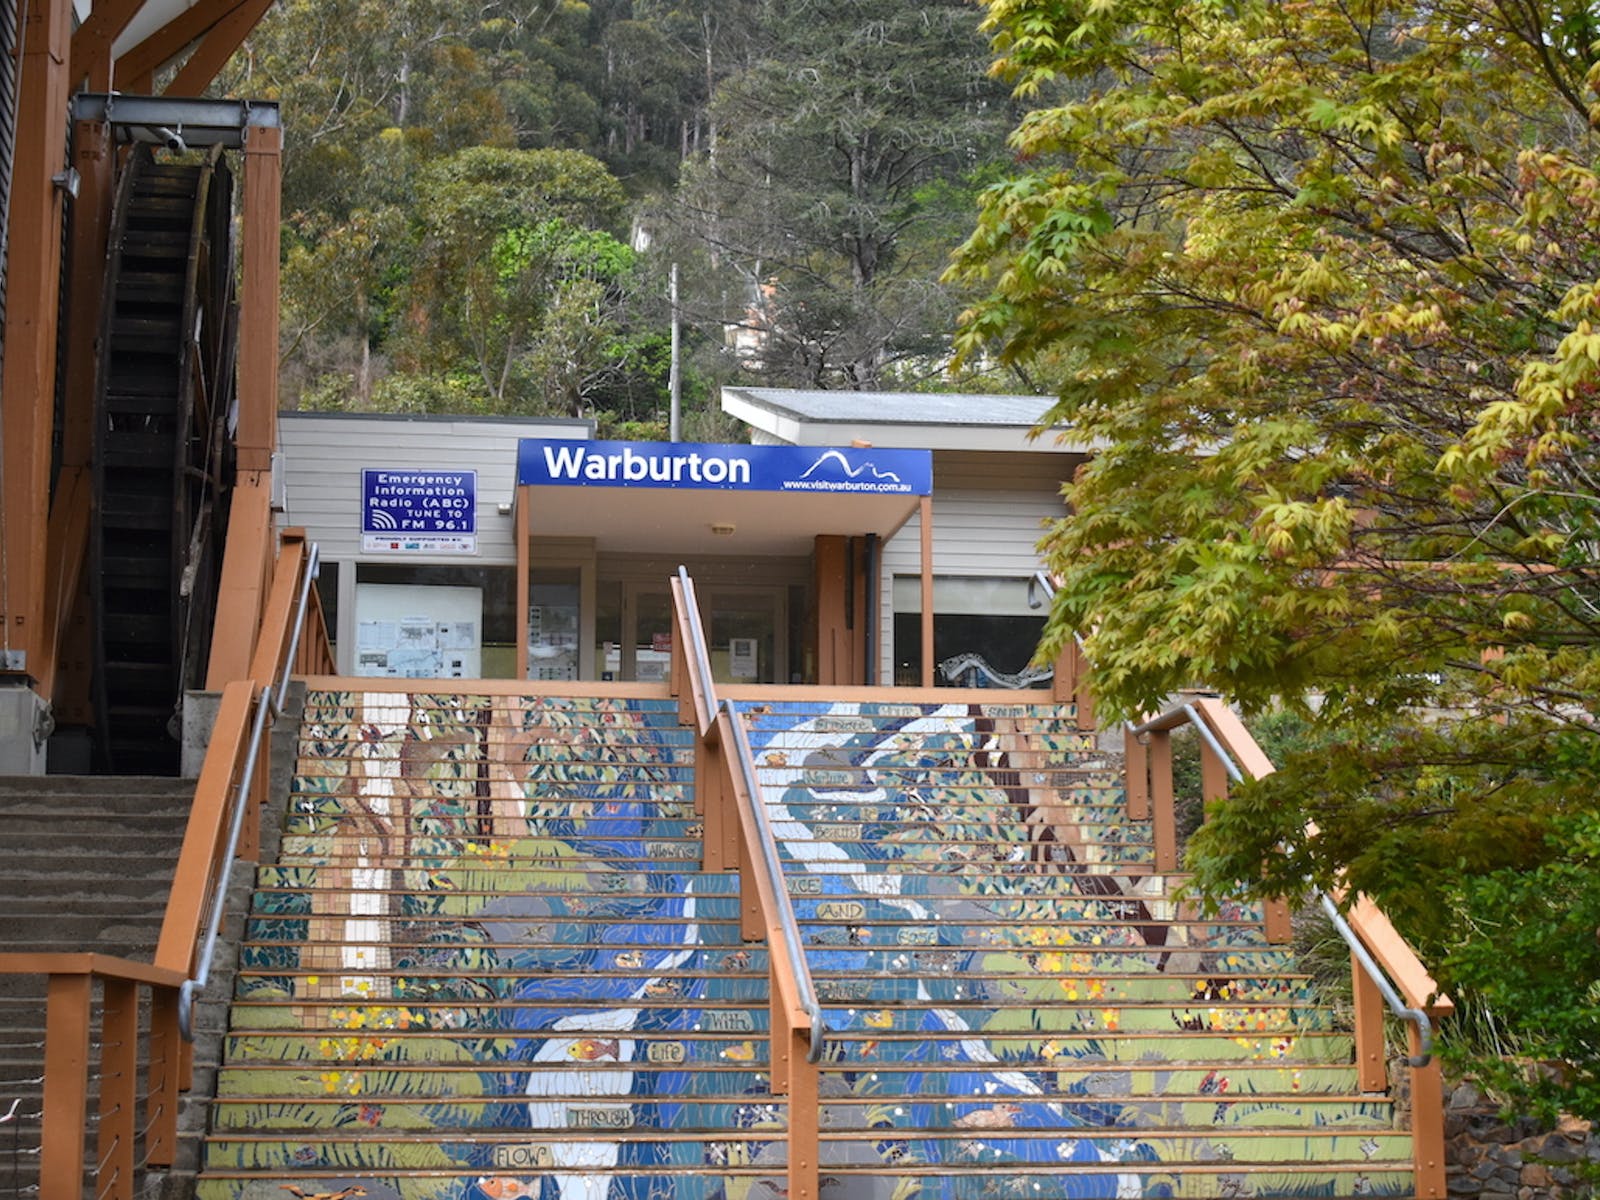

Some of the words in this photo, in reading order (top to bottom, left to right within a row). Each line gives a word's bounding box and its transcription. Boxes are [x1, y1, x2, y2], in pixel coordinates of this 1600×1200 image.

[543, 446, 751, 484] Warburton
[378, 474, 463, 486] Emergency
[783, 480, 912, 492] www.visitwarburton.com.au
[375, 486, 465, 496] Information
[369, 497, 412, 507] Radio
[422, 498, 470, 509] (ABC)
[407, 509, 441, 518] TUNE
[447, 510, 463, 519] TO
[402, 520, 426, 529] FM
[435, 520, 467, 530] 96.1
[820, 903, 863, 918] AND
[574, 1109, 630, 1127] THROUGH
[496, 1147, 547, 1166] FLOW
